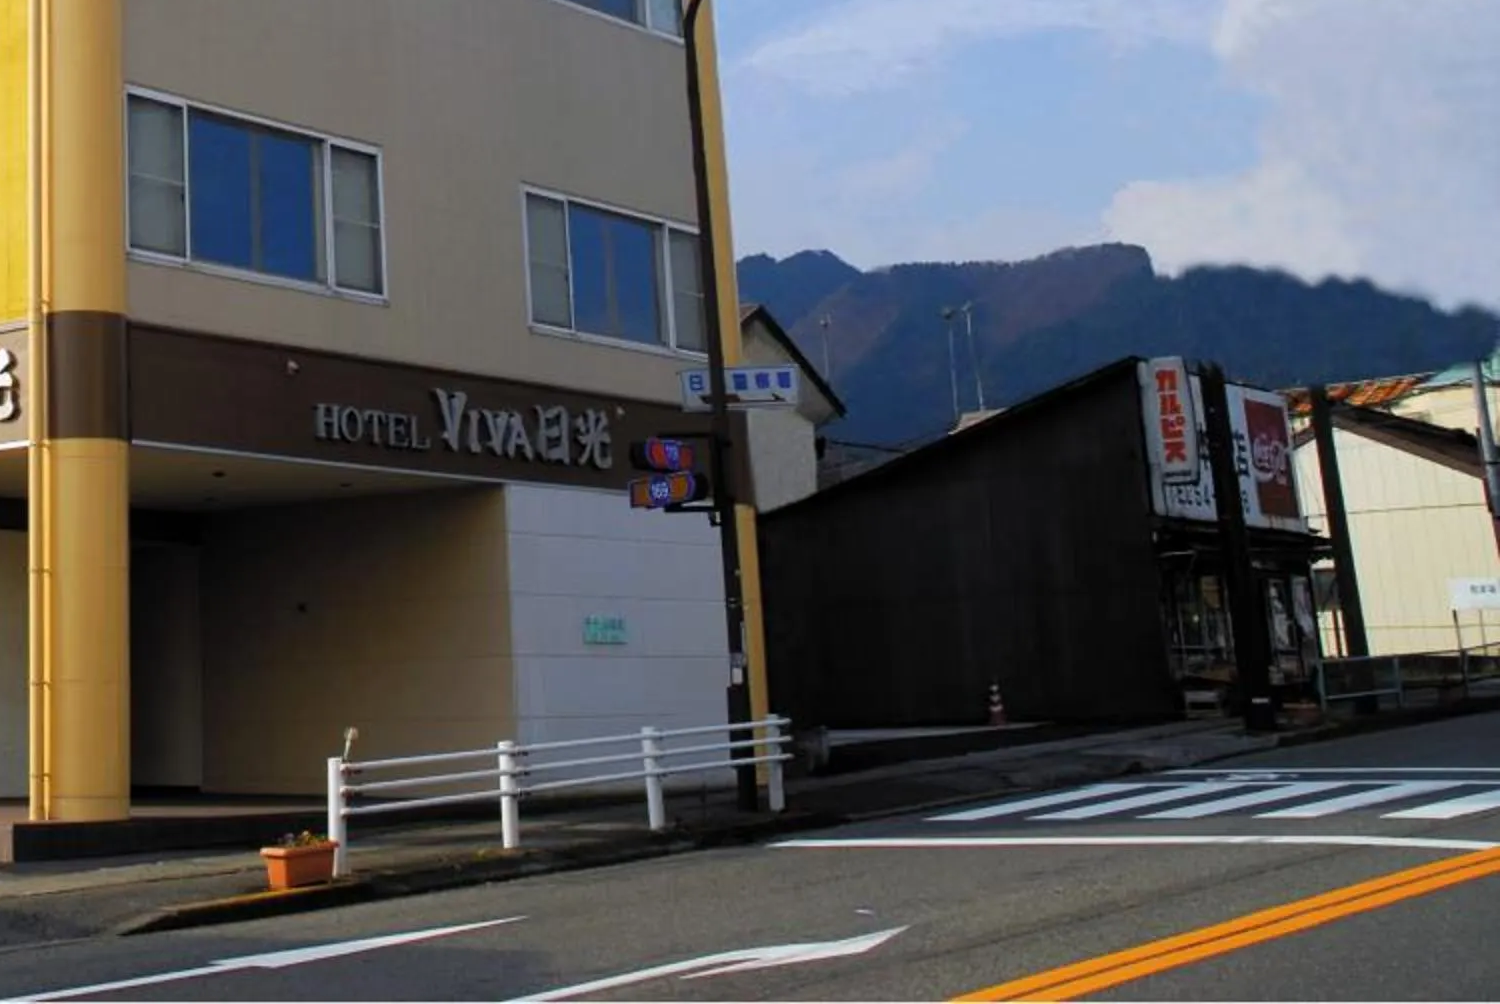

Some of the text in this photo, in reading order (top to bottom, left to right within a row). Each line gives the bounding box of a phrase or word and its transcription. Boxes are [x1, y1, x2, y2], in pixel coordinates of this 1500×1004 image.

[316, 403, 431, 450] HOTEL
[532, 404, 613, 470] 日光
[1155, 369, 1187, 464] カルピス
